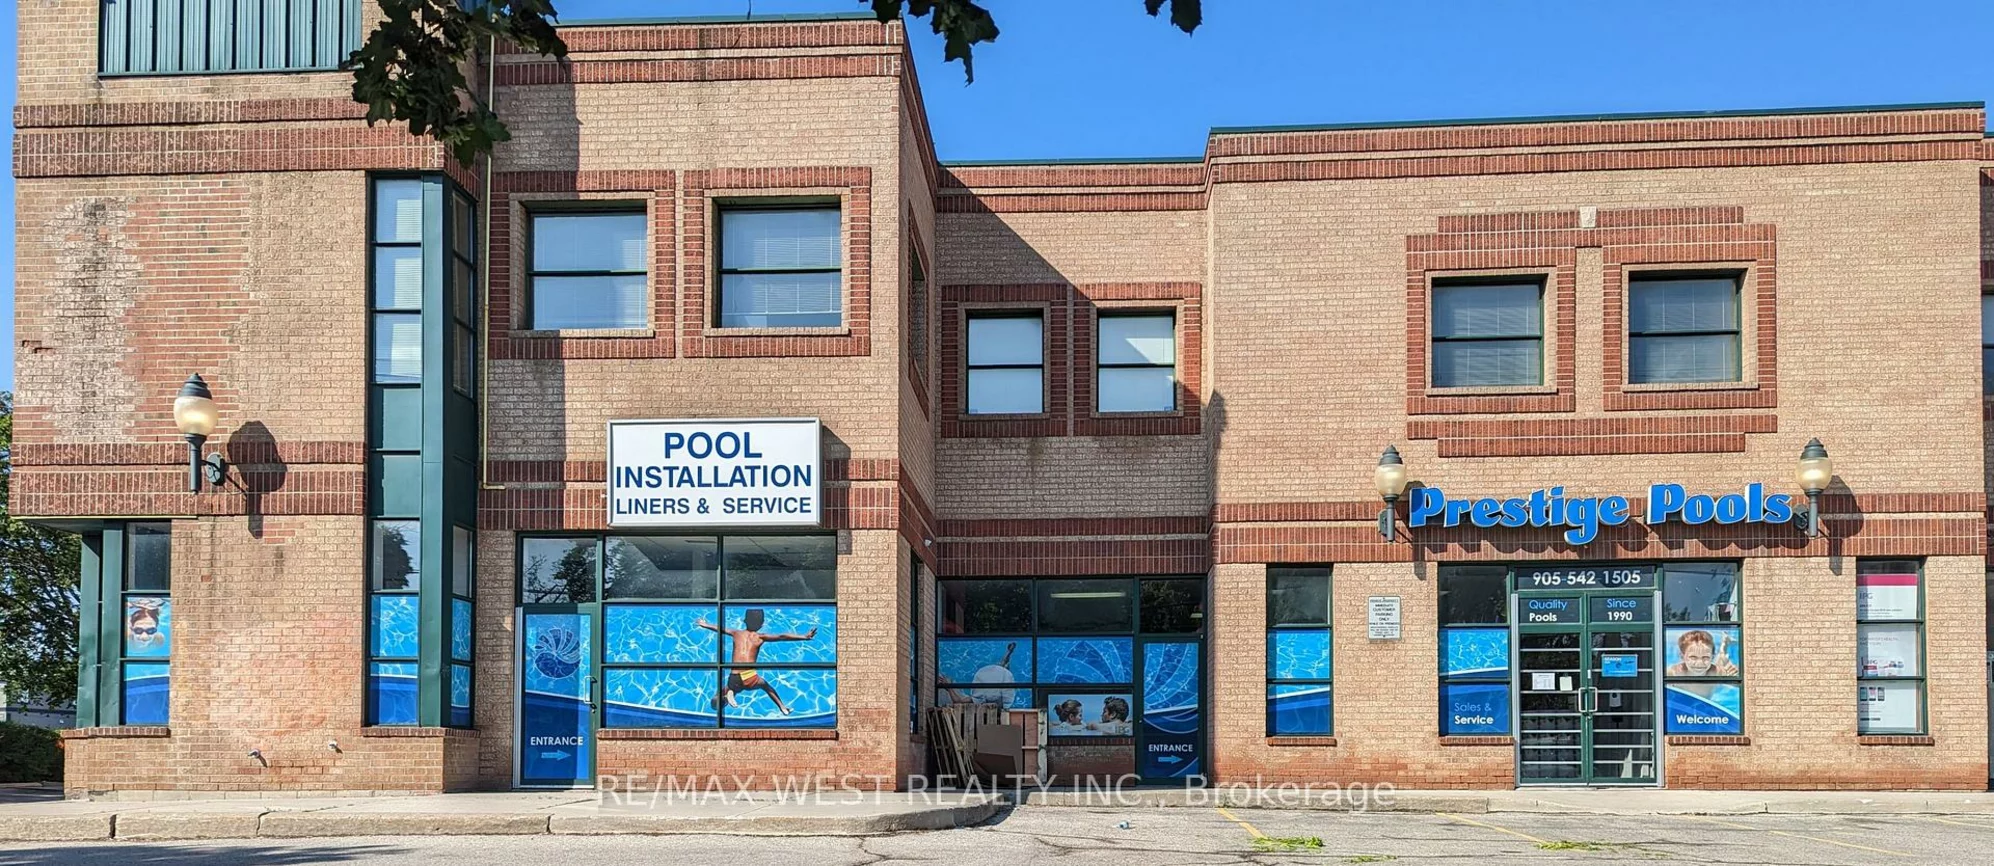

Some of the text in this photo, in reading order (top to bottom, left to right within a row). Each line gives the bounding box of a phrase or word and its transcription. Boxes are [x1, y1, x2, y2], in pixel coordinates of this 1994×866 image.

[664, 431, 763, 459] POOL
[616, 465, 811, 488] INSTALLATION
[616, 497, 812, 514] LINERS & SERVICE
[1409, 482, 1793, 546] Prestige Pools
[1528, 599, 1568, 611] Quality
[1606, 598, 1637, 609] Since
[1529, 612, 1558, 622] Pools
[1607, 611, 1633, 621] 1990
[1454, 702, 1492, 712] Sales &
[1454, 715, 1494, 725] Service
[1676, 714, 1729, 725] Welcome
[530, 736, 584, 746] ENTRANCE
[1148, 744, 1193, 752] ENTRANCE
